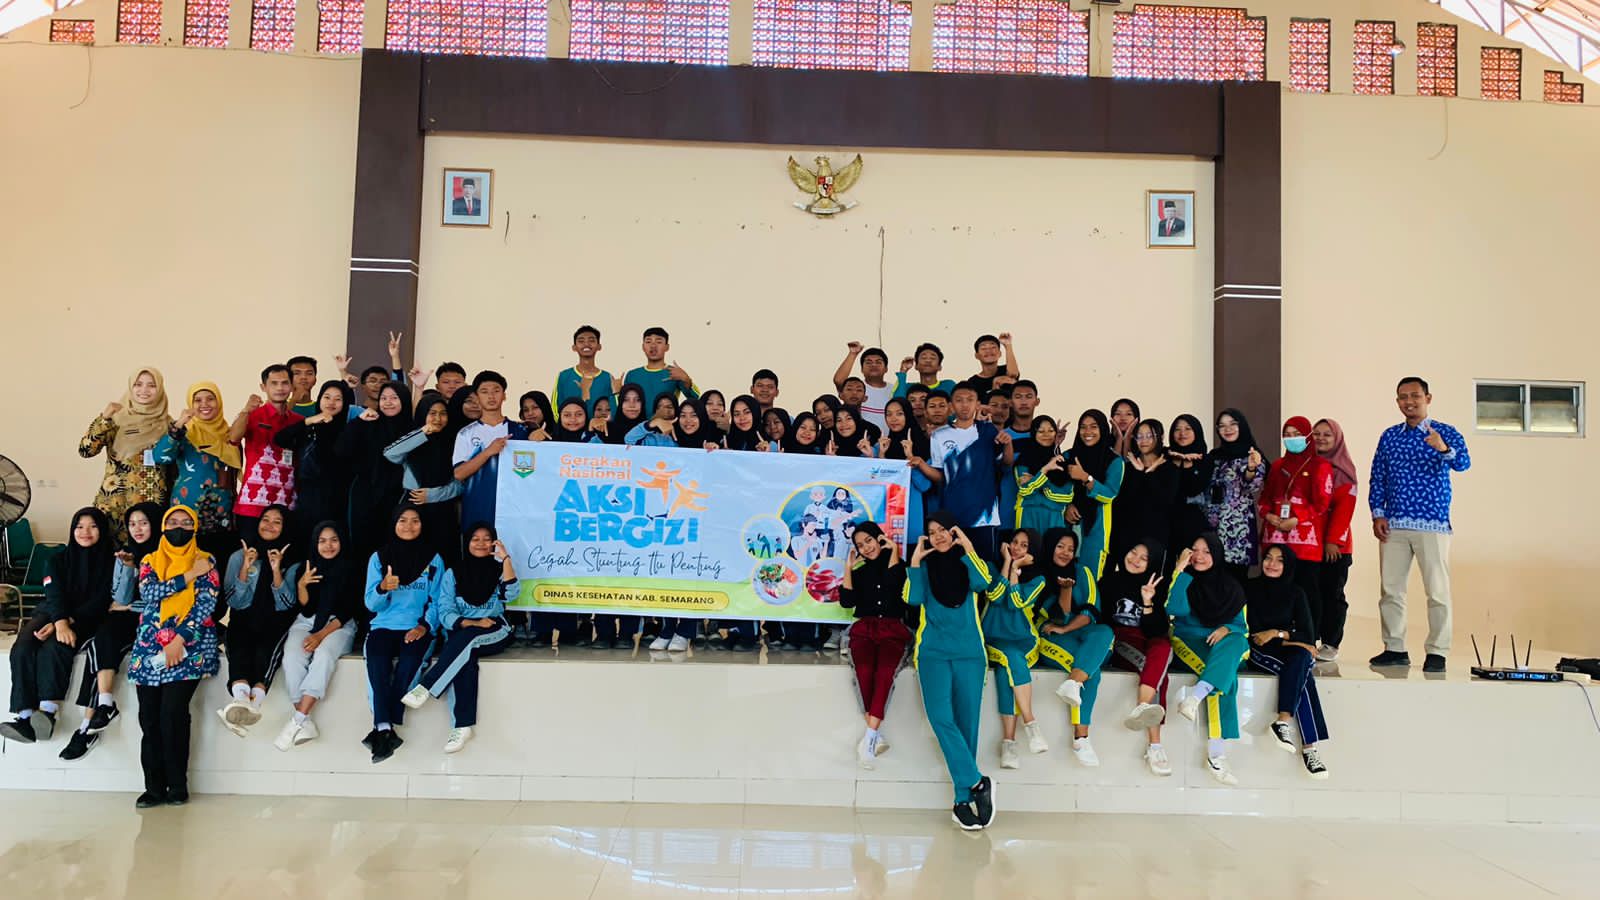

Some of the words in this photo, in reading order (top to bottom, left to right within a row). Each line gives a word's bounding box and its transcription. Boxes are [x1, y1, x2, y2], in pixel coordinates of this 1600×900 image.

[560, 453, 632, 468] Gerakan
[559, 466, 632, 481] Nasional
[553, 479, 646, 516] AKSI
[554, 511, 699, 548] BERGIZI
[527, 546, 579, 570] Cegah
[583, 547, 645, 577] Stunting
[670, 551, 726, 580] Penting
[543, 590, 574, 599] DINAS
[576, 592, 633, 602] KESEHATAN
[635, 594, 657, 603] KAB.
[660, 595, 715, 605] SEMARANG
